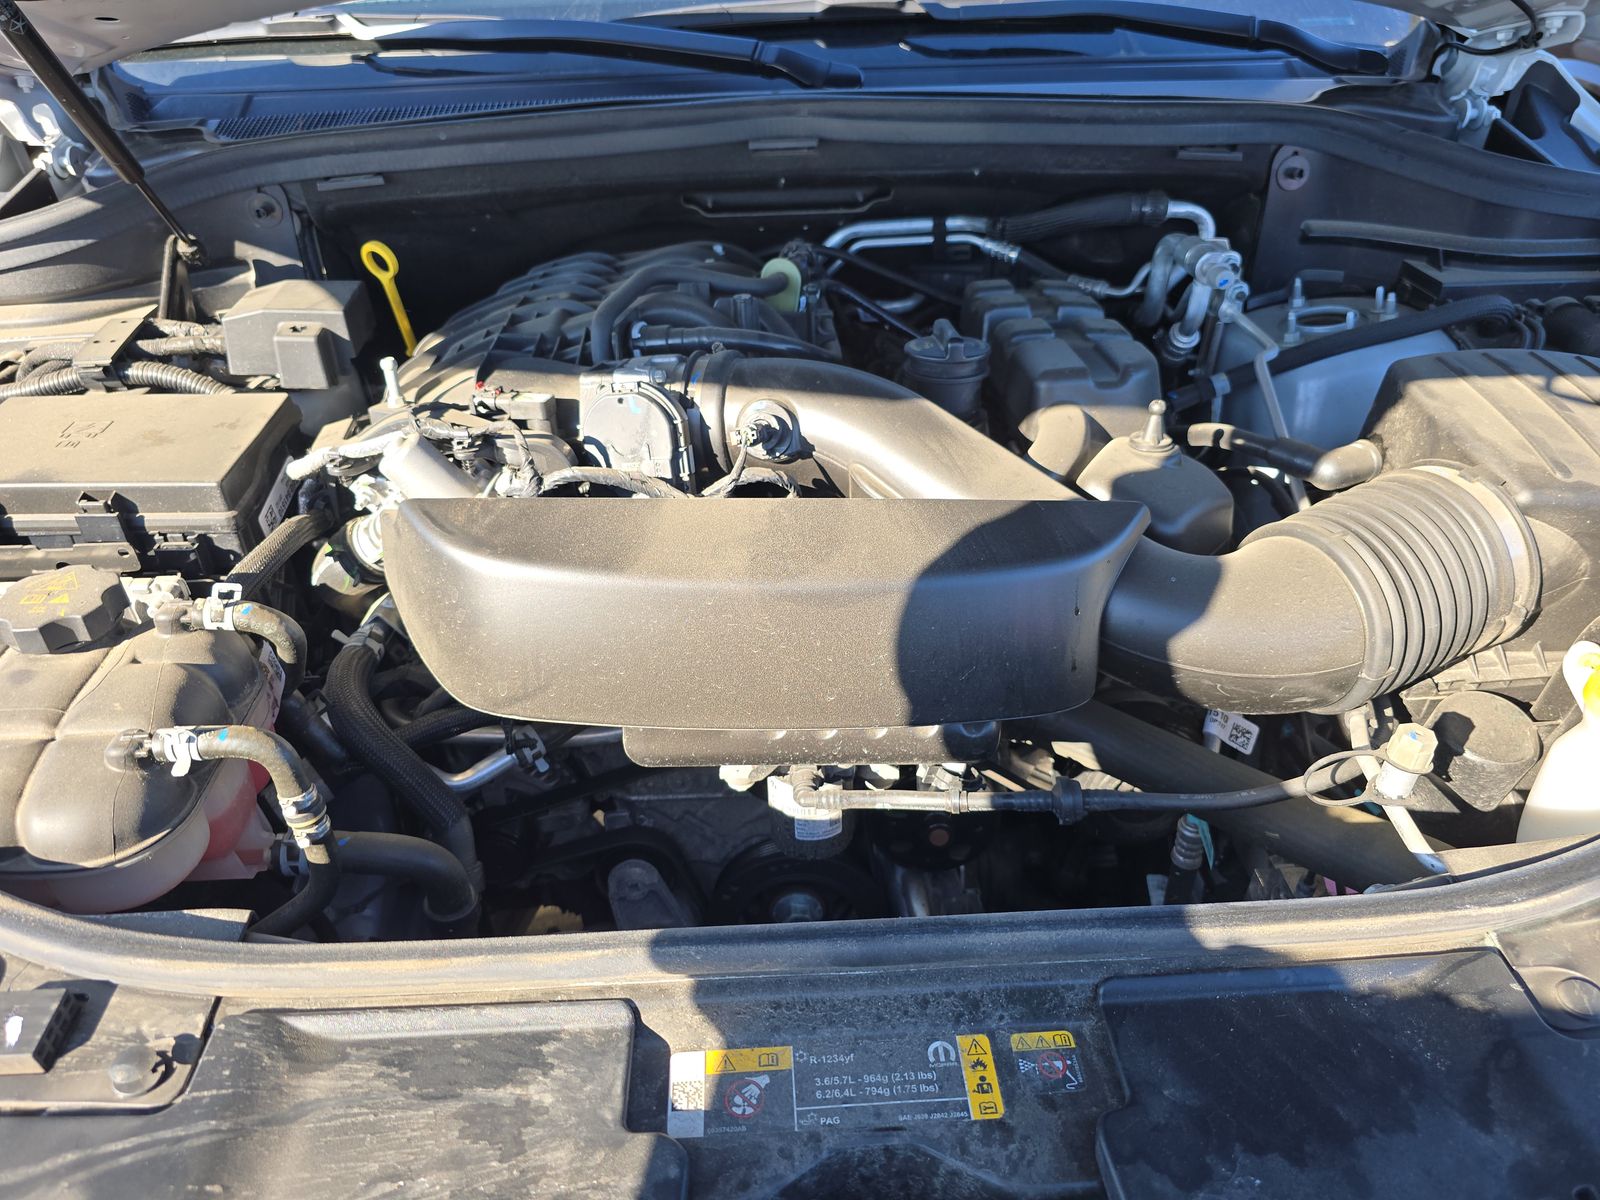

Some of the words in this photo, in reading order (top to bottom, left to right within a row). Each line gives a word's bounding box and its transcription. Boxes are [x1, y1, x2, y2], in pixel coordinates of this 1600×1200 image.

[809, 1054, 855, 1066] R-1234yf
[815, 1075, 855, 1086] 3.6/5.7L
[863, 1074, 889, 1085] 964g
[891, 1072, 915, 1083] (2.13
[918, 1071, 937, 1082] lbs)
[815, 1088, 856, 1099] 6.2/6.4L
[865, 1086, 890, 1097] 794g
[893, 1084, 918, 1096] (1.75
[920, 1083, 939, 1094] lbs)
[820, 1116, 841, 1125] PAG
